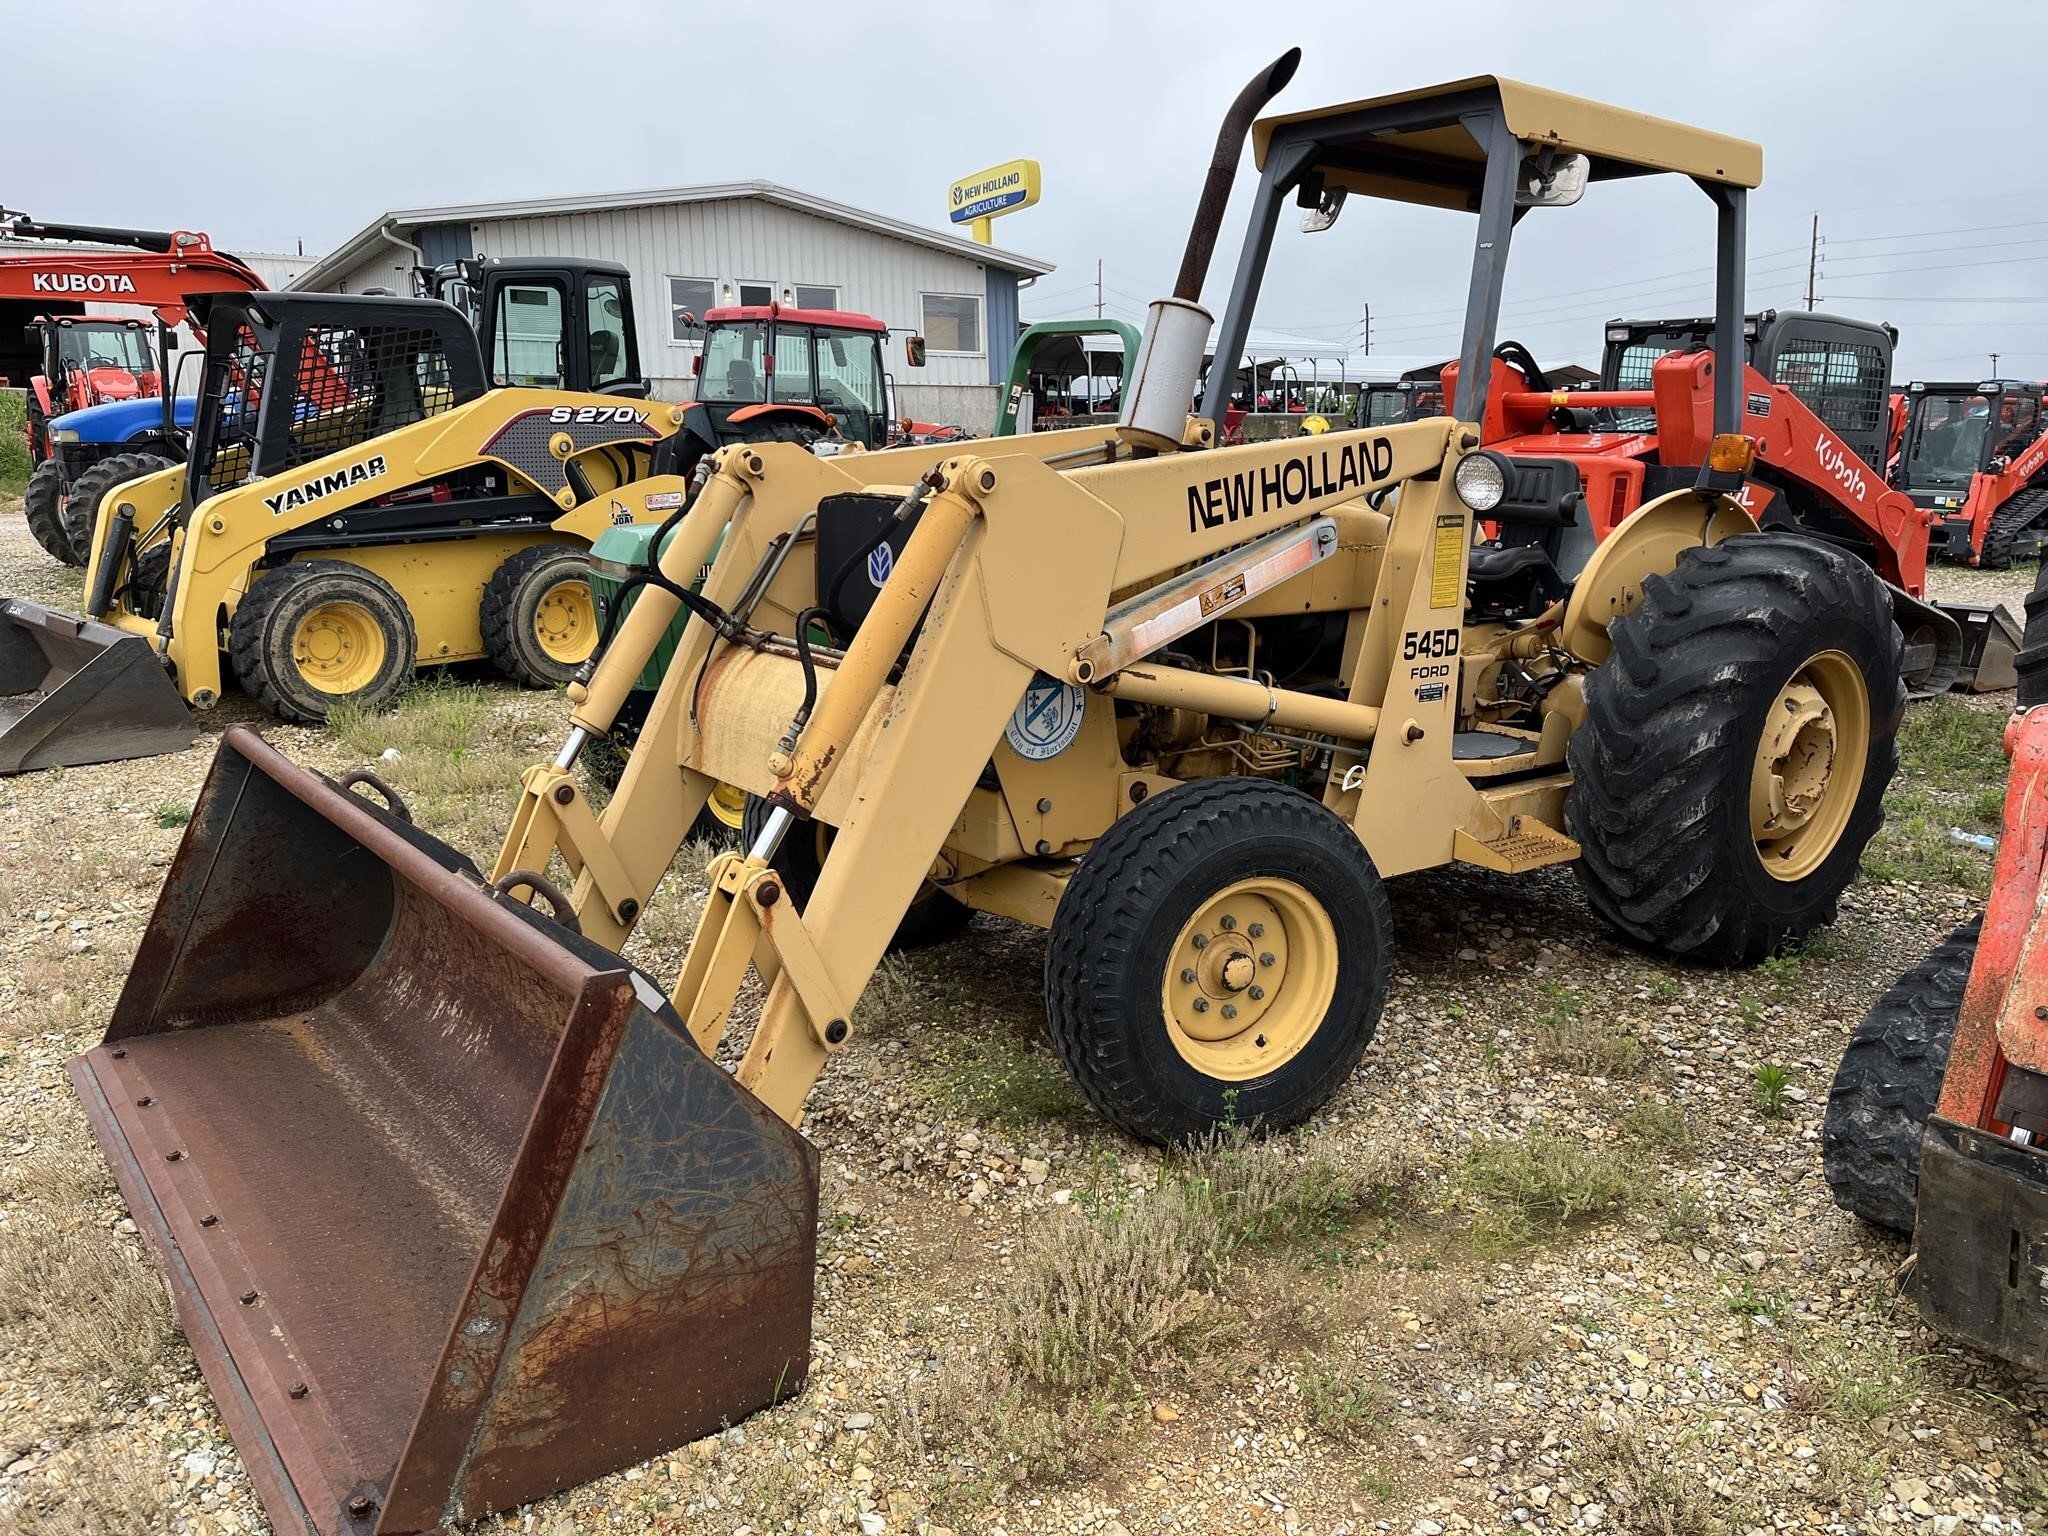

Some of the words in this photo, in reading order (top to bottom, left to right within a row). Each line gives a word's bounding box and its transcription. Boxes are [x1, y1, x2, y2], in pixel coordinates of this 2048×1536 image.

[964, 184, 980, 200] NEW
[982, 172, 1020, 195] HOLLAND
[964, 195, 1007, 217] AGRICULTURE
[32, 273, 137, 293] KUBOTA
[1815, 433, 1867, 502] Kubota
[263, 456, 386, 515] YANMAR
[1187, 470, 1255, 533] NEW
[1260, 437, 1393, 513] HOLLAND
[1403, 629, 1459, 661] 545D
[1410, 664, 1449, 680] FORD
[1010, 729, 1024, 750] City
[1025, 747, 1035, 756] of
